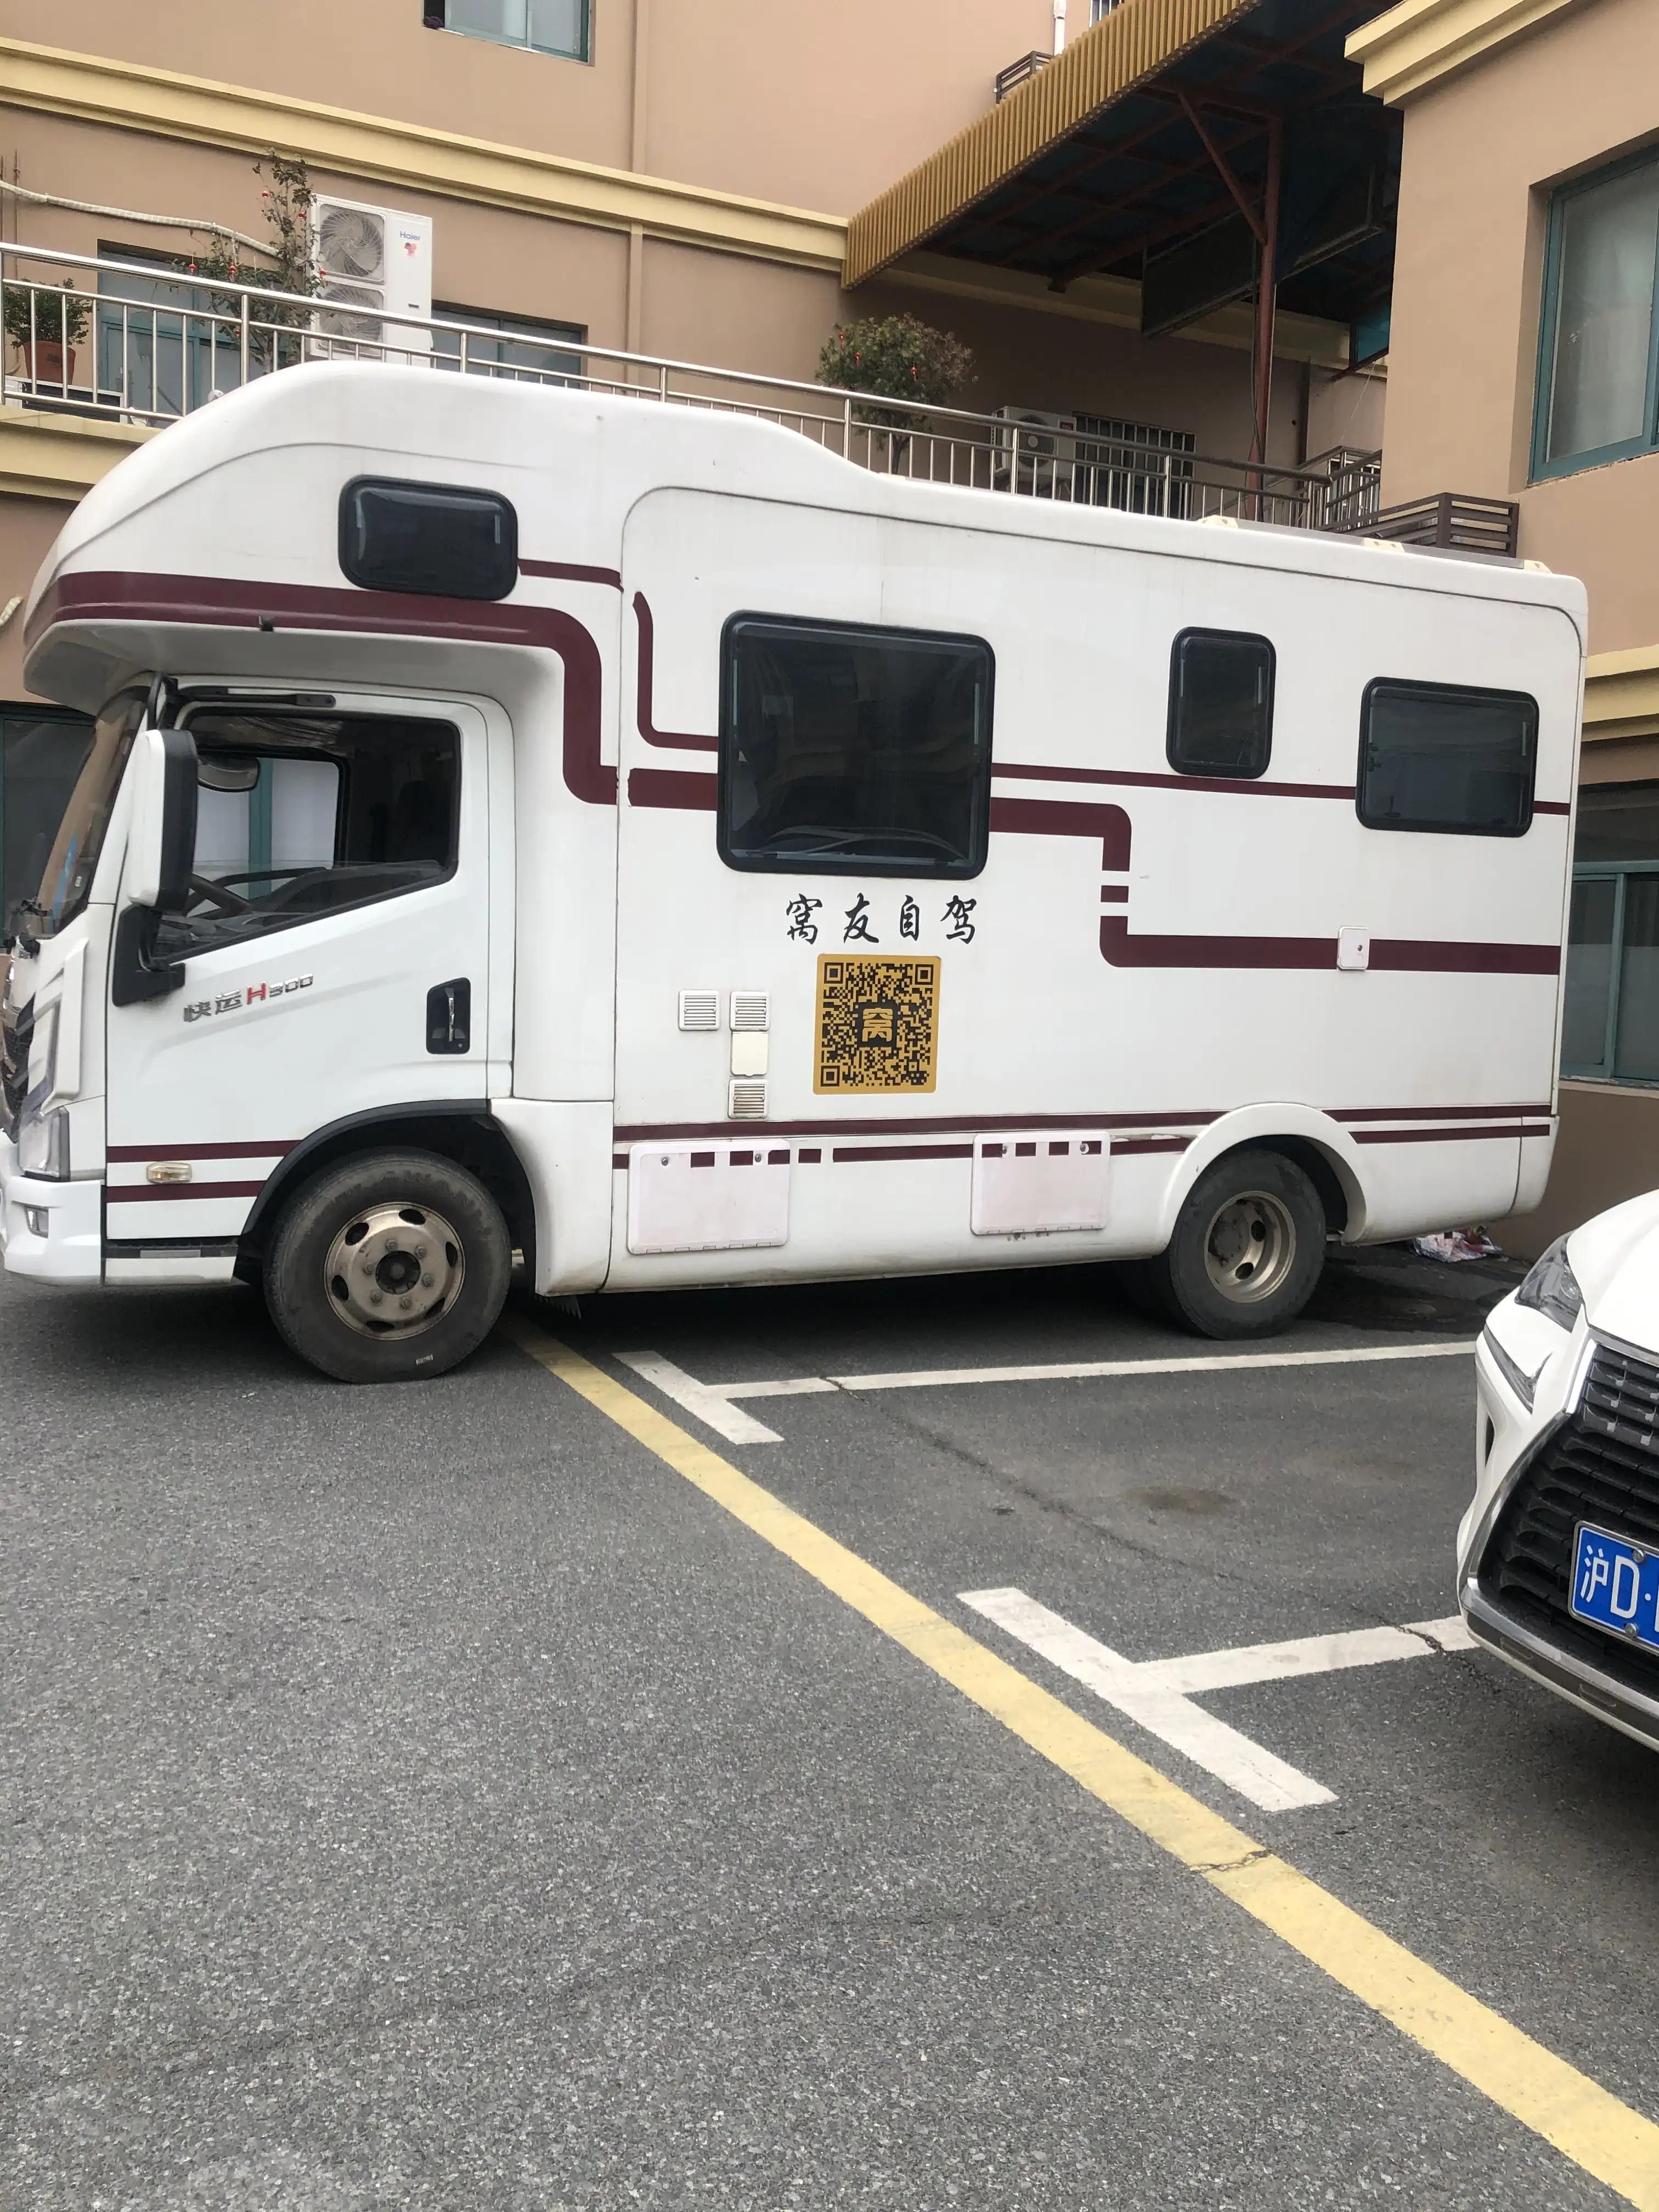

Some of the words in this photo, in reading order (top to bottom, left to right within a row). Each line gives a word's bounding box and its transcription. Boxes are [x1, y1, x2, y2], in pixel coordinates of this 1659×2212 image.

[399, 230, 420, 240] Haier
[786, 892, 977, 945] 窝友自驾
[1580, 1544, 1659, 1633] 沪D·
